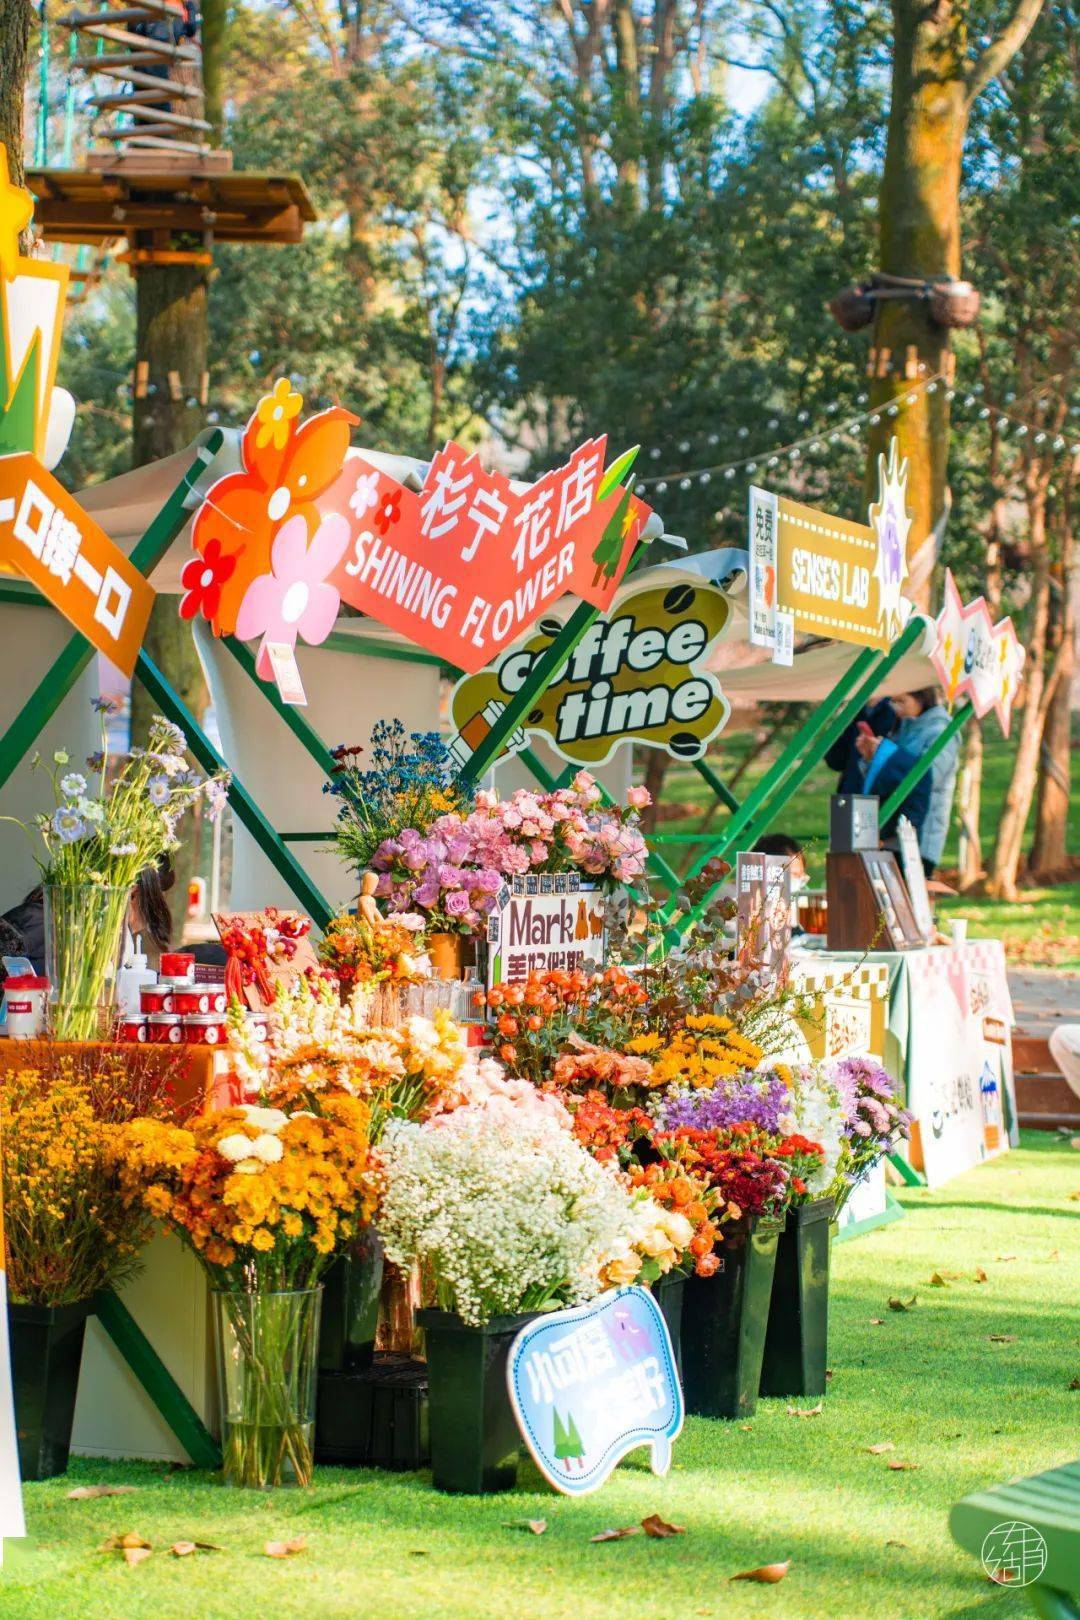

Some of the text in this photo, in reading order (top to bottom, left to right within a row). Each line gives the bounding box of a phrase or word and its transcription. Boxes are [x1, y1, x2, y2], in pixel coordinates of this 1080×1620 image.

[420, 453, 600, 574] 杉宁花店
[346, 532, 576, 649] SHINING FLOWER
[791, 547, 840, 601] SENSES
[842, 562, 870, 609] LAB
[556, 680, 714, 743] time
[509, 899, 574, 946] Mark
